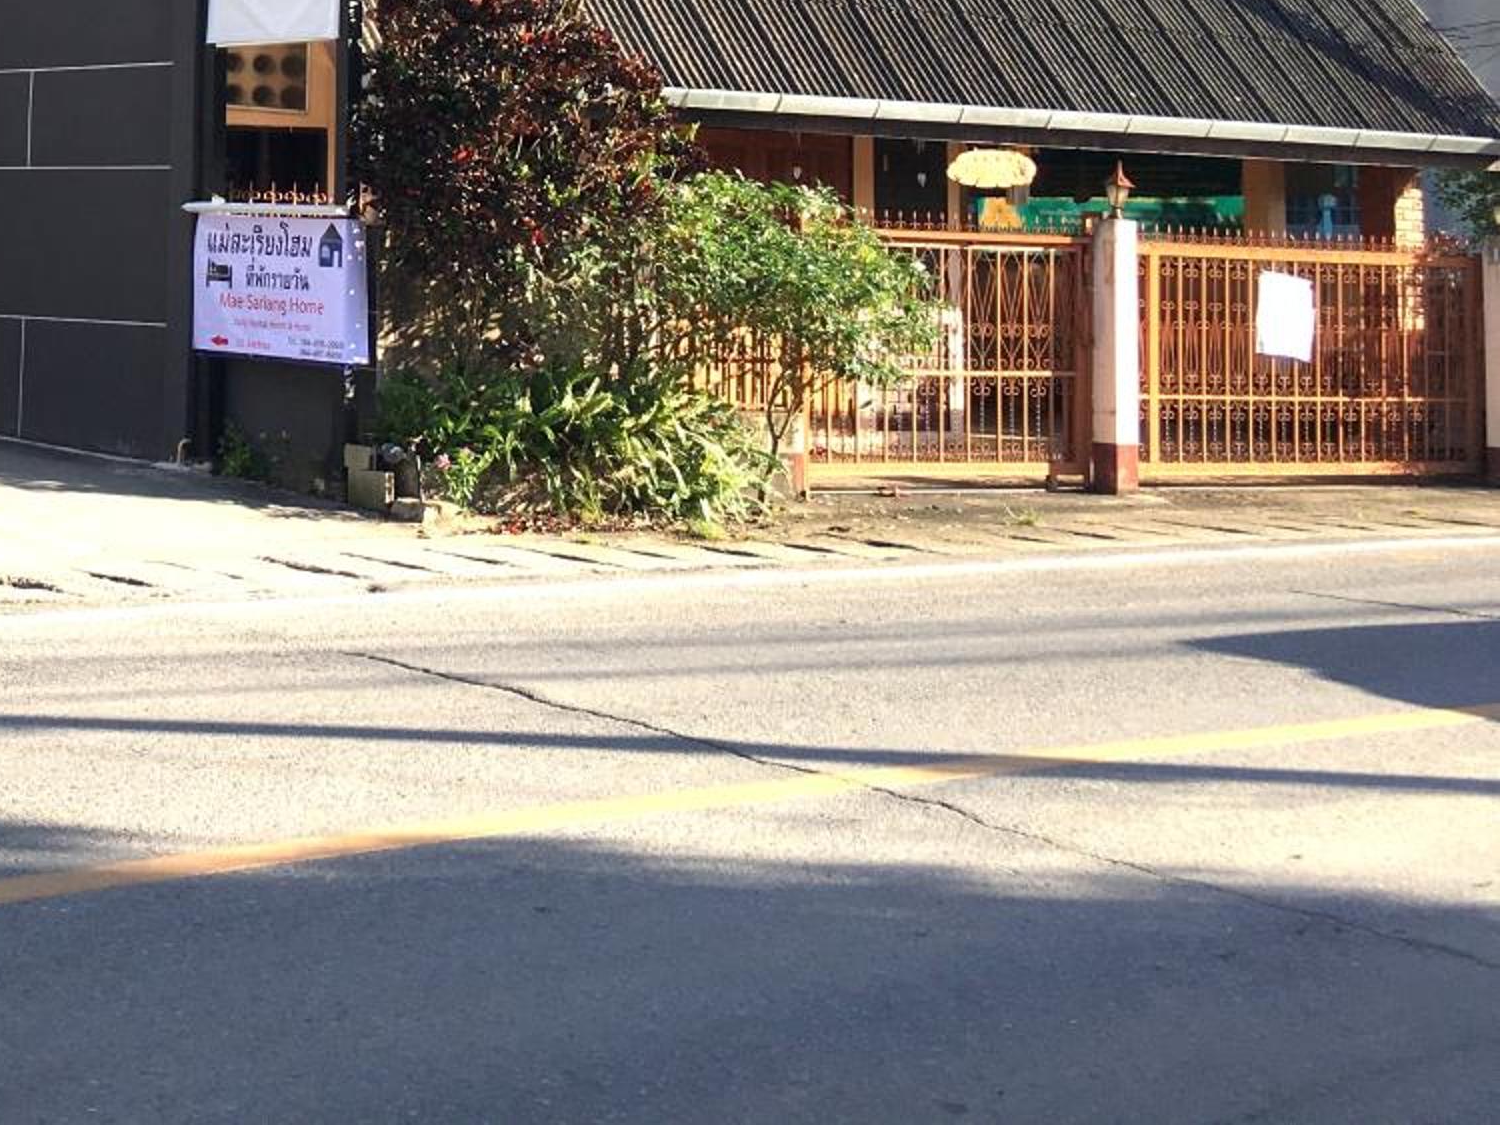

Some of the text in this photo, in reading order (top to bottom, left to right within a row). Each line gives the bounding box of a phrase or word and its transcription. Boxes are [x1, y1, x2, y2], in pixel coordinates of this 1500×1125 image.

[220, 293, 325, 316] Mae Sariang Home
